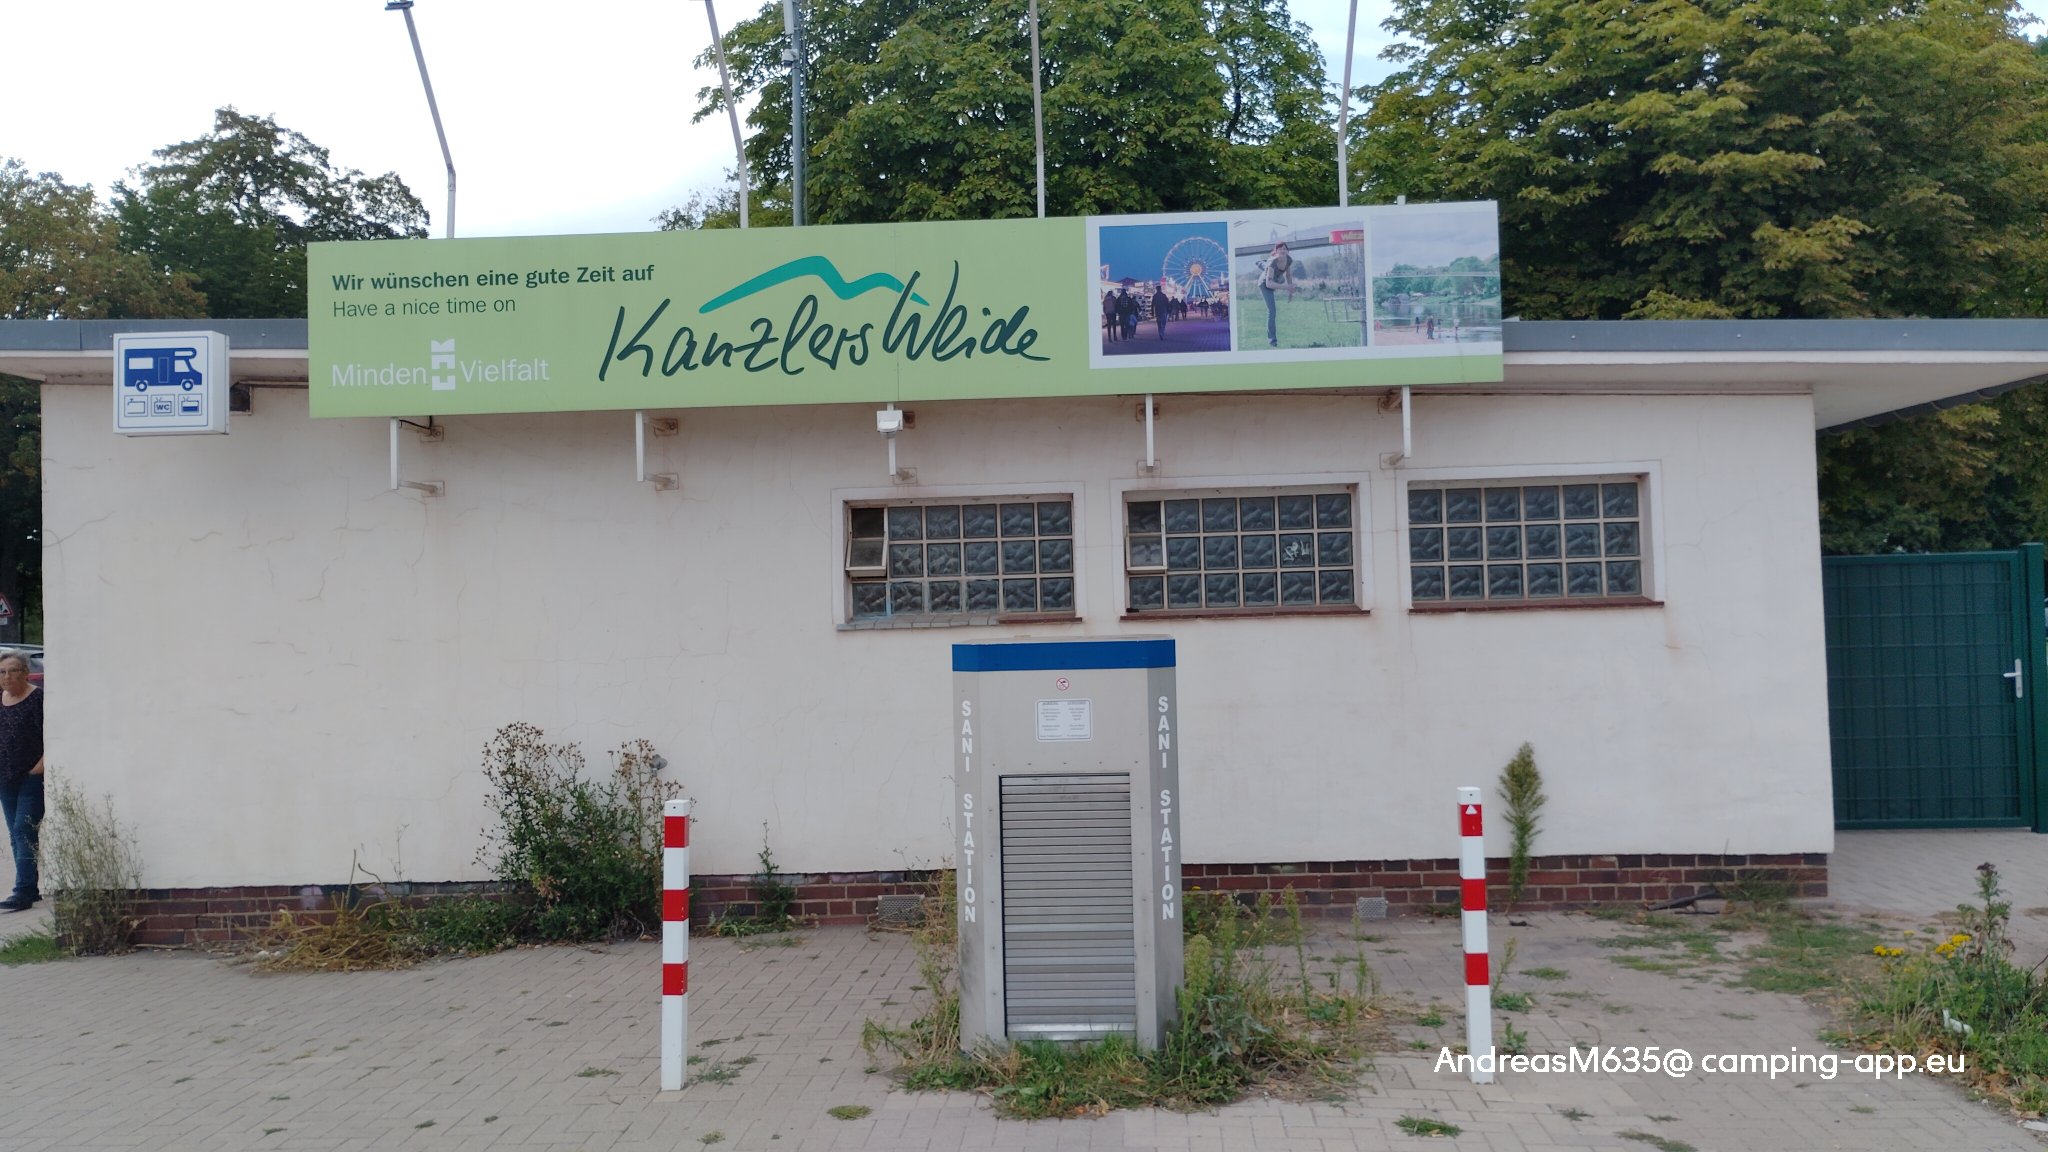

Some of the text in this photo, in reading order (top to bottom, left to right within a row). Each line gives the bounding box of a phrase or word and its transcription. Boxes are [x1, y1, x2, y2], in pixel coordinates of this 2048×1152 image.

[332, 264, 655, 291] Wir wünschen eine gute Zeit auf
[333, 297, 516, 317] Have a nice time on
[332, 358, 550, 387] Minden Vielfalt
[156, 403, 170, 411] WC
[961, 700, 976, 923] SANI STATION
[1158, 696, 1175, 920] SANI STATION
